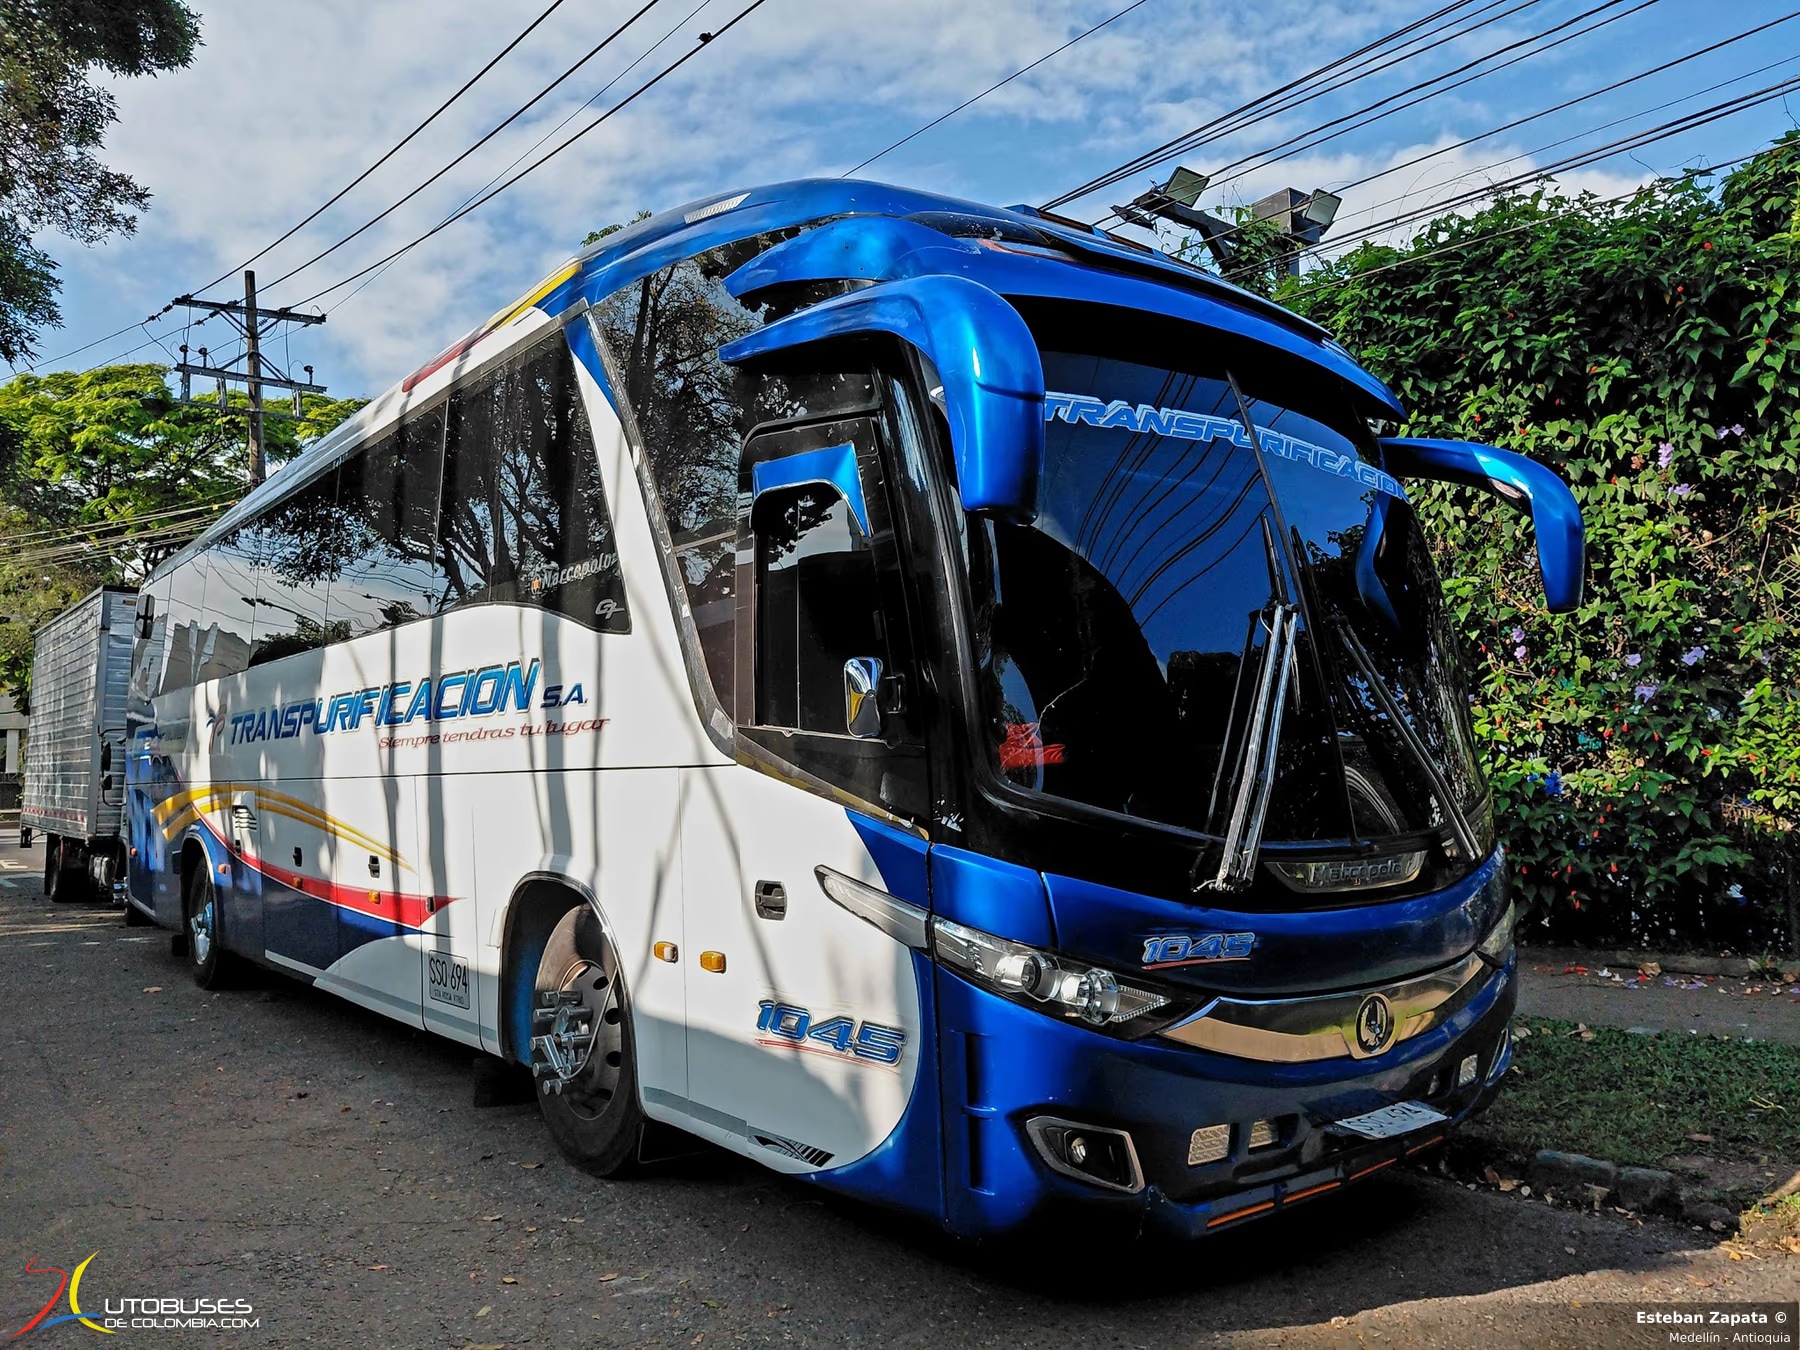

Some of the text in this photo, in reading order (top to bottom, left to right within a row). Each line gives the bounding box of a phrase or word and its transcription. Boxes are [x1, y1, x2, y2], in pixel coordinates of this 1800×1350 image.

[230, 657, 588, 745] TRANSPURIFICACION S.A.
[378, 717, 611, 749] Siempre tendras tu lugar
[1142, 932, 1255, 963] 1045
[450, 963, 467, 993] 694
[756, 999, 909, 1067] 1045
